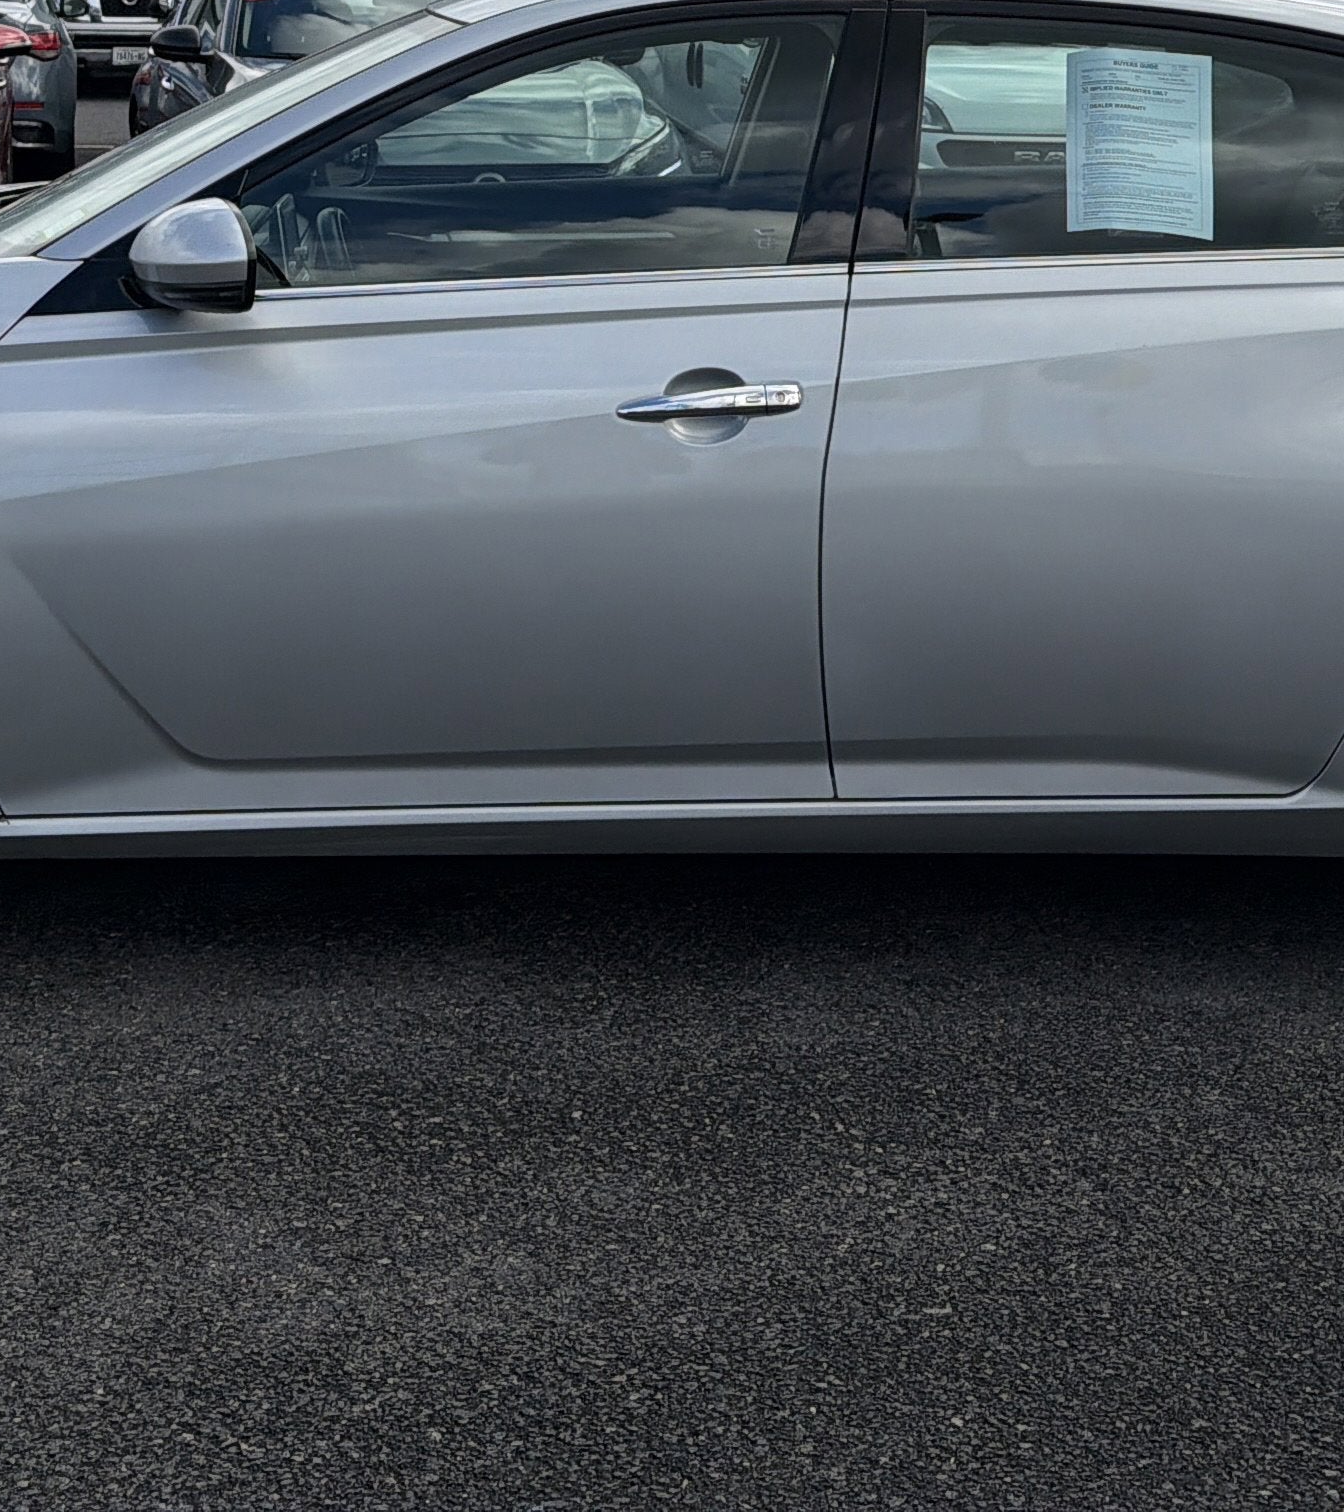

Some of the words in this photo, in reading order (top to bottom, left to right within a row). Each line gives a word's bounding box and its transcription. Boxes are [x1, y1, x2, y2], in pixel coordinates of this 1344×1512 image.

[1113, 60, 1138, 68] BUYERS
[1139, 62, 1159, 70] GUIDE
[1114, 103, 1147, 111] WARRANTY
[1013, 150, 1065, 163] RA
